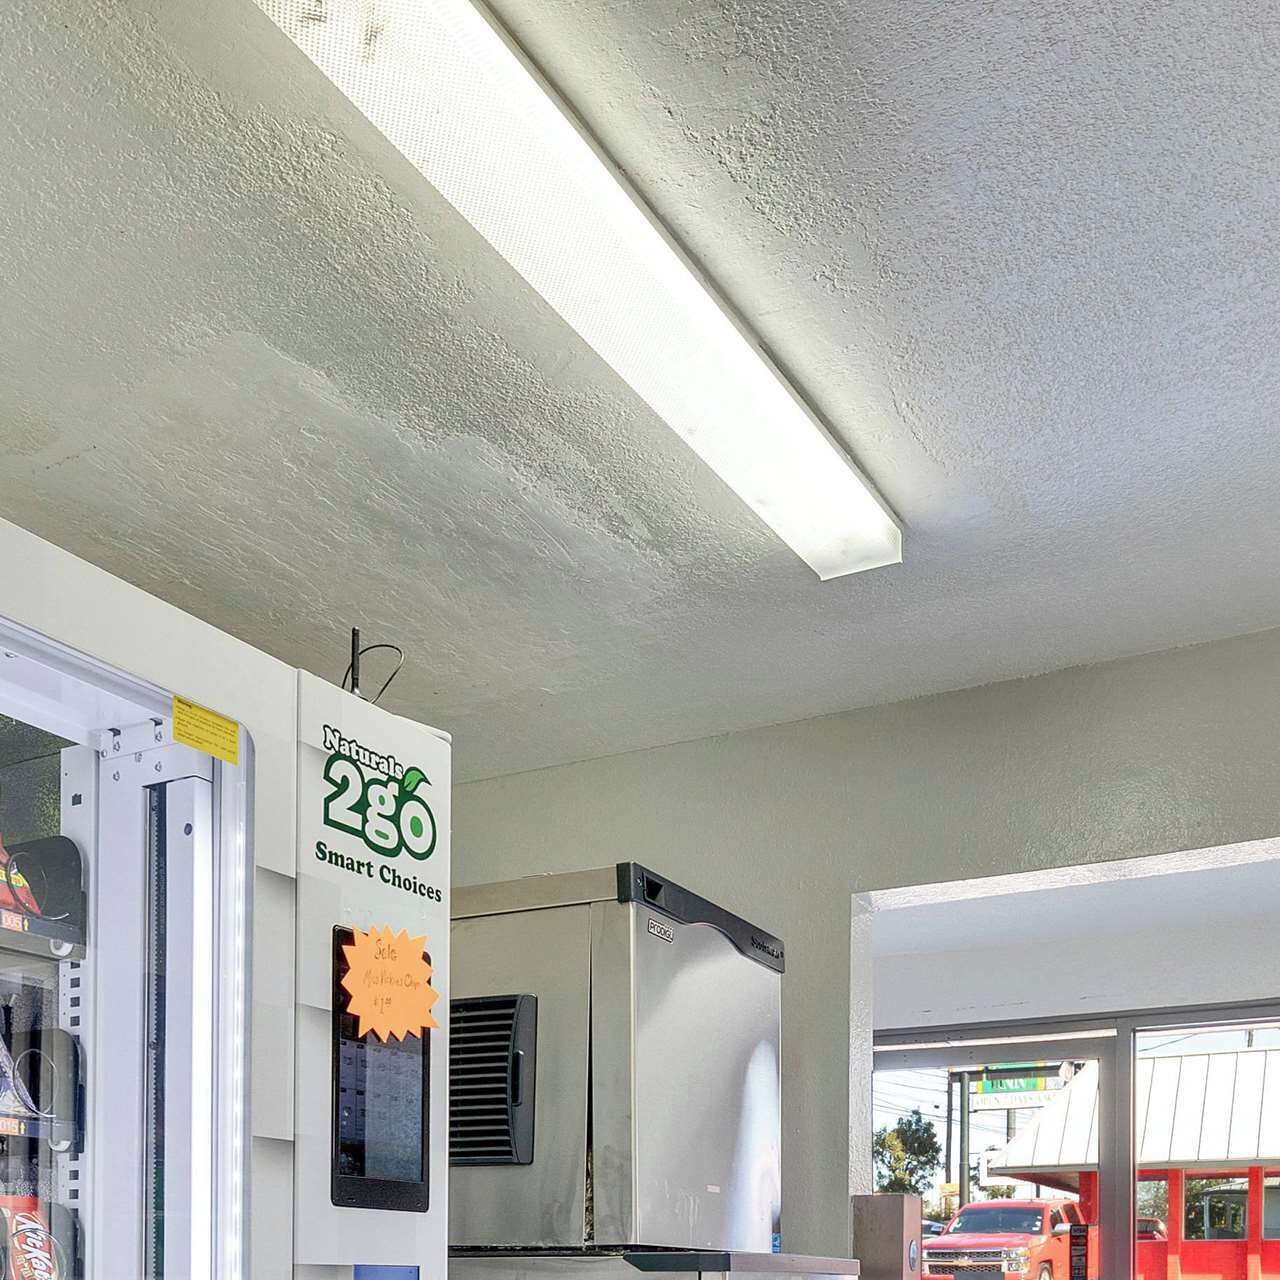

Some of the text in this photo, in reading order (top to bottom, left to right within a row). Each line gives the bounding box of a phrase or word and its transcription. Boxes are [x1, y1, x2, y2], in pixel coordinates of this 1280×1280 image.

[324, 725, 403, 780] Naturals
[323, 755, 437, 860] 2go
[316, 842, 442, 903] Smart Choices
[0, 1121, 18, 1131] 015
